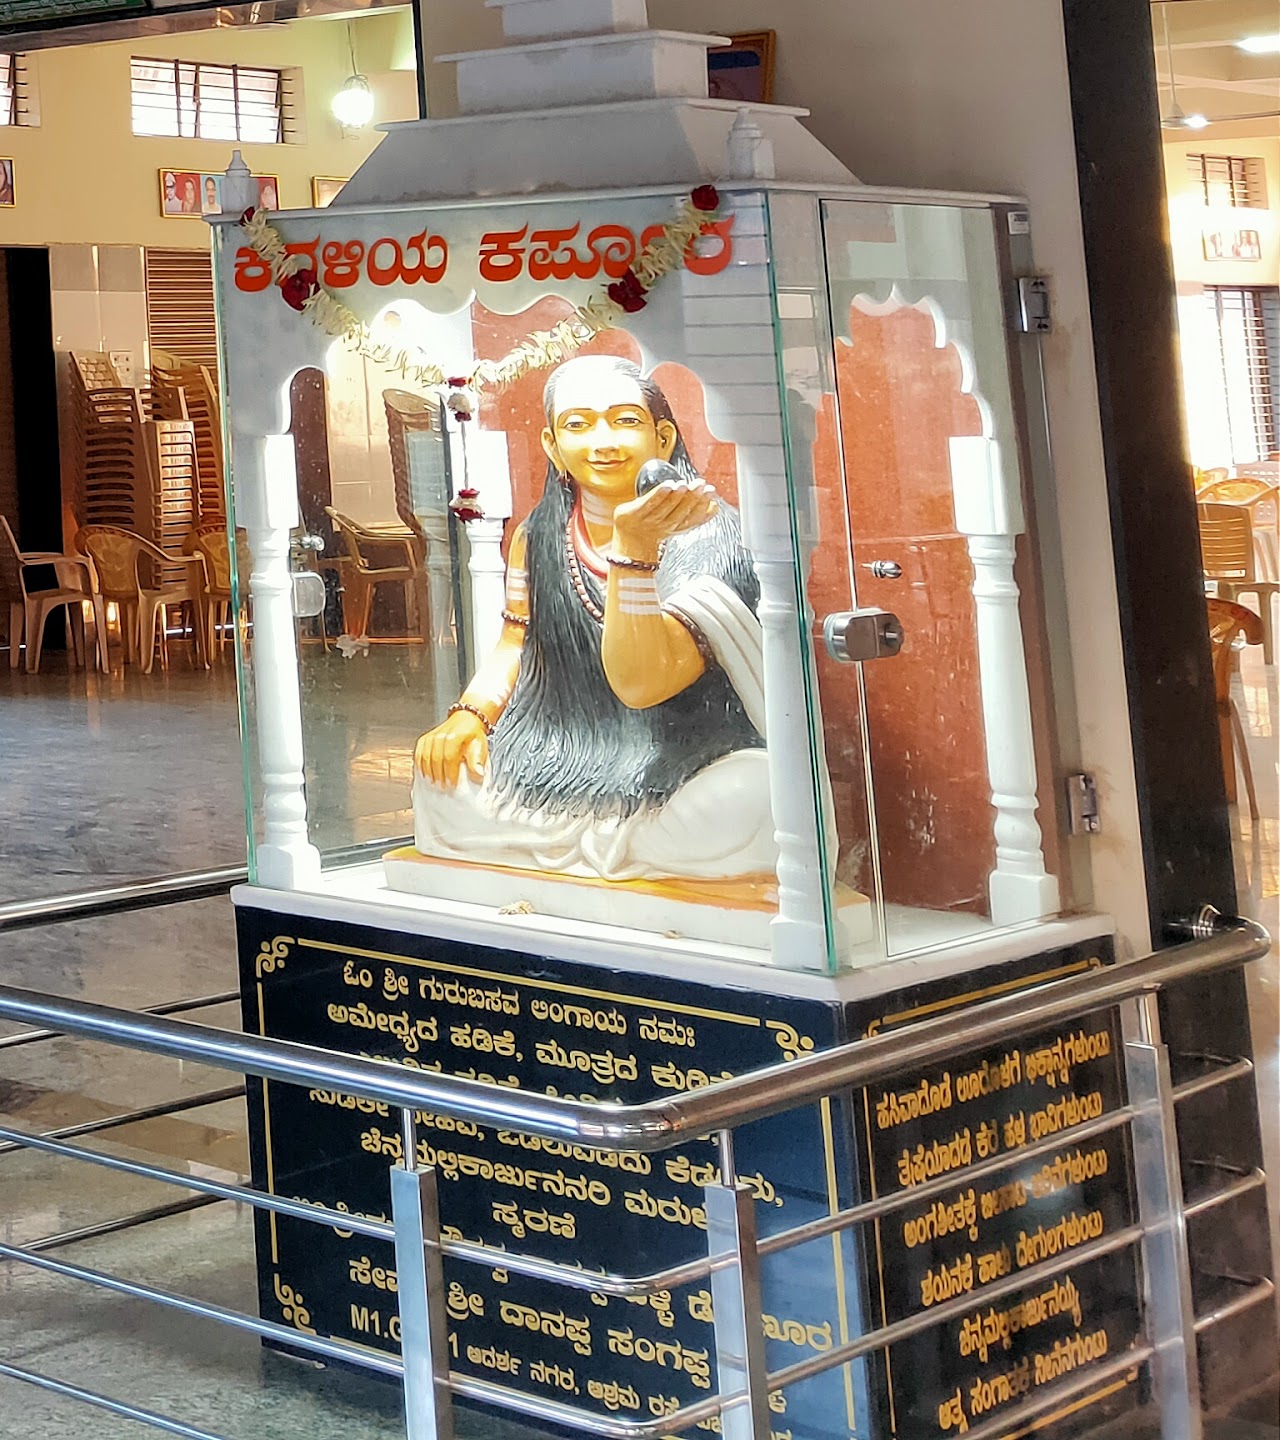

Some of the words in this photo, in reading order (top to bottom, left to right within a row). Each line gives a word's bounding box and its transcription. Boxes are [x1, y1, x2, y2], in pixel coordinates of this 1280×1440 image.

[327, 1001, 438, 1053] ಅಮೇಧ್ಯದ
[450, 1023, 523, 1063] ಹಡಿಕೆ,
[535, 1038, 638, 1085] ಮೂತ್ರದ
[343, 960, 372, 989] ಓಂ
[383, 967, 409, 1001] ಶ್ರೀ
[418, 973, 520, 1015] ಗುರುಬಸವ
[531, 997, 627, 1035] ಲಿಂಗಾಯ
[639, 1015, 696, 1048] ನಮಃ
[492, 1200, 576, 1239] ಸ್ಮರಣೆ
[446, 1281, 485, 1320] ಶ್ರೀ
[499, 1300, 591, 1356] ದಾನಪ್ಪ
[607, 1326, 711, 1389] ಸಂಗಪ್ಪ
[530, 1359, 580, 1396] ನಗರ,
